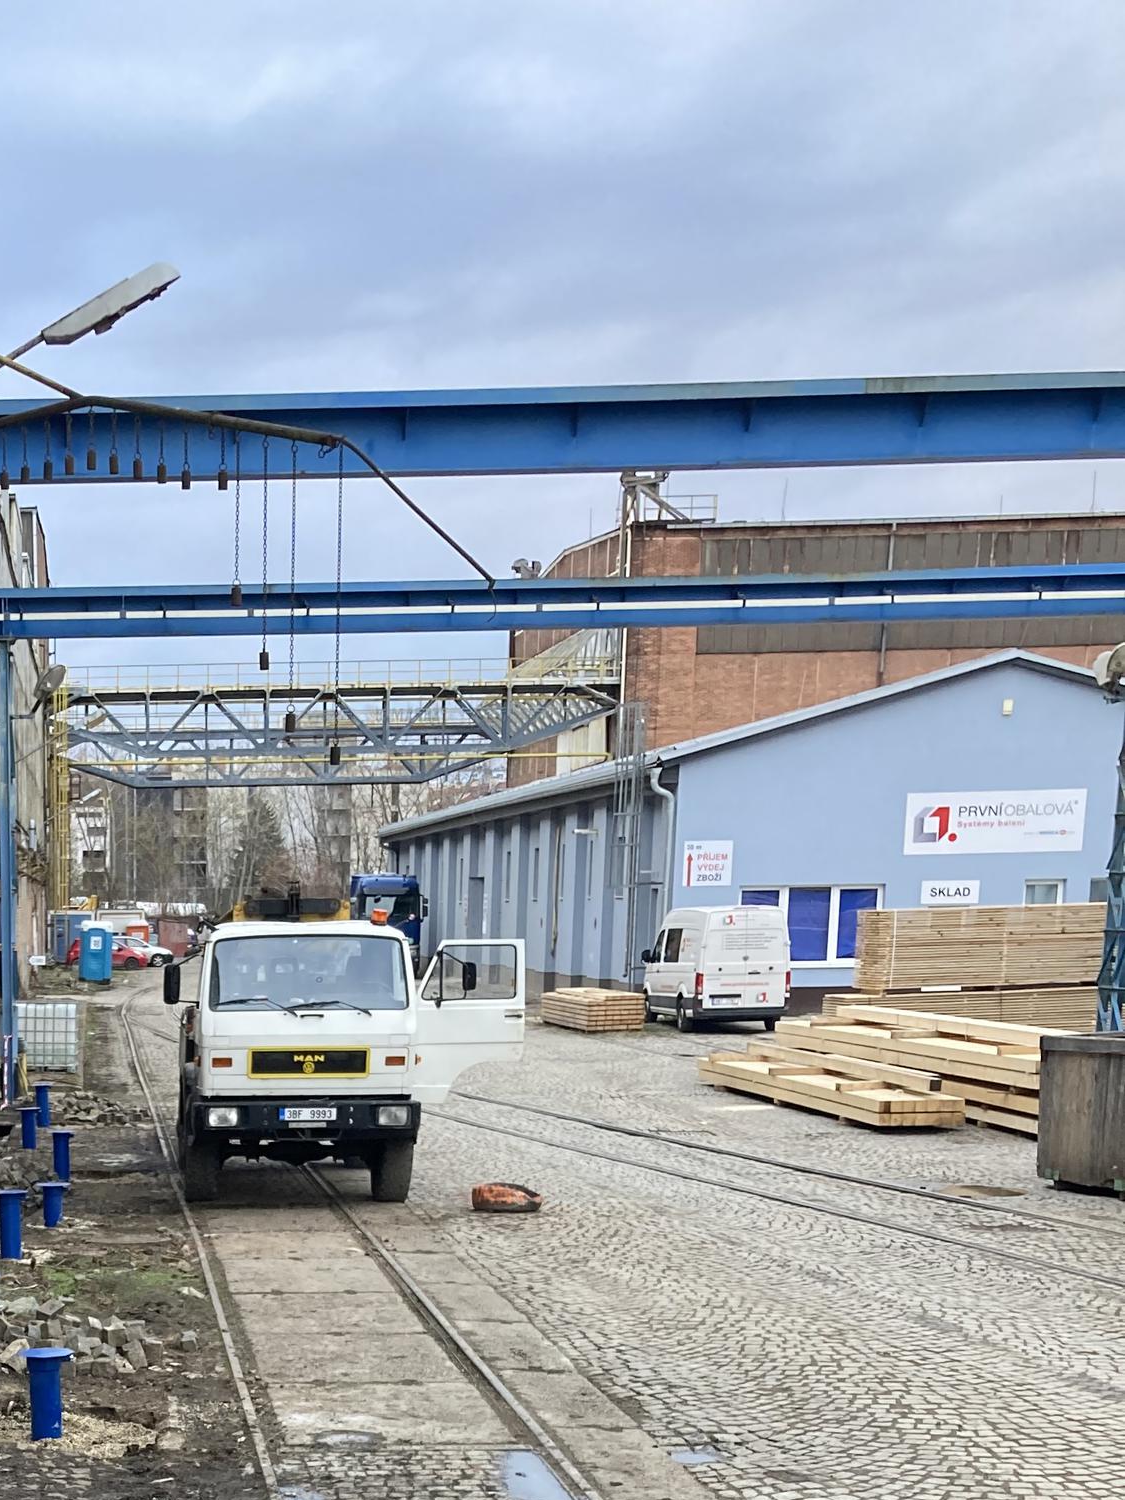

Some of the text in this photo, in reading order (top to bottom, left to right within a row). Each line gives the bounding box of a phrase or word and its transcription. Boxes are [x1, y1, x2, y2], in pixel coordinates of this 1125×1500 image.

[696, 872, 722, 882] ZBOŽÍ
[930, 887, 971, 898] SKLAD
[293, 1054, 325, 1062] MAN
[309, 1109, 333, 1119] 9993
